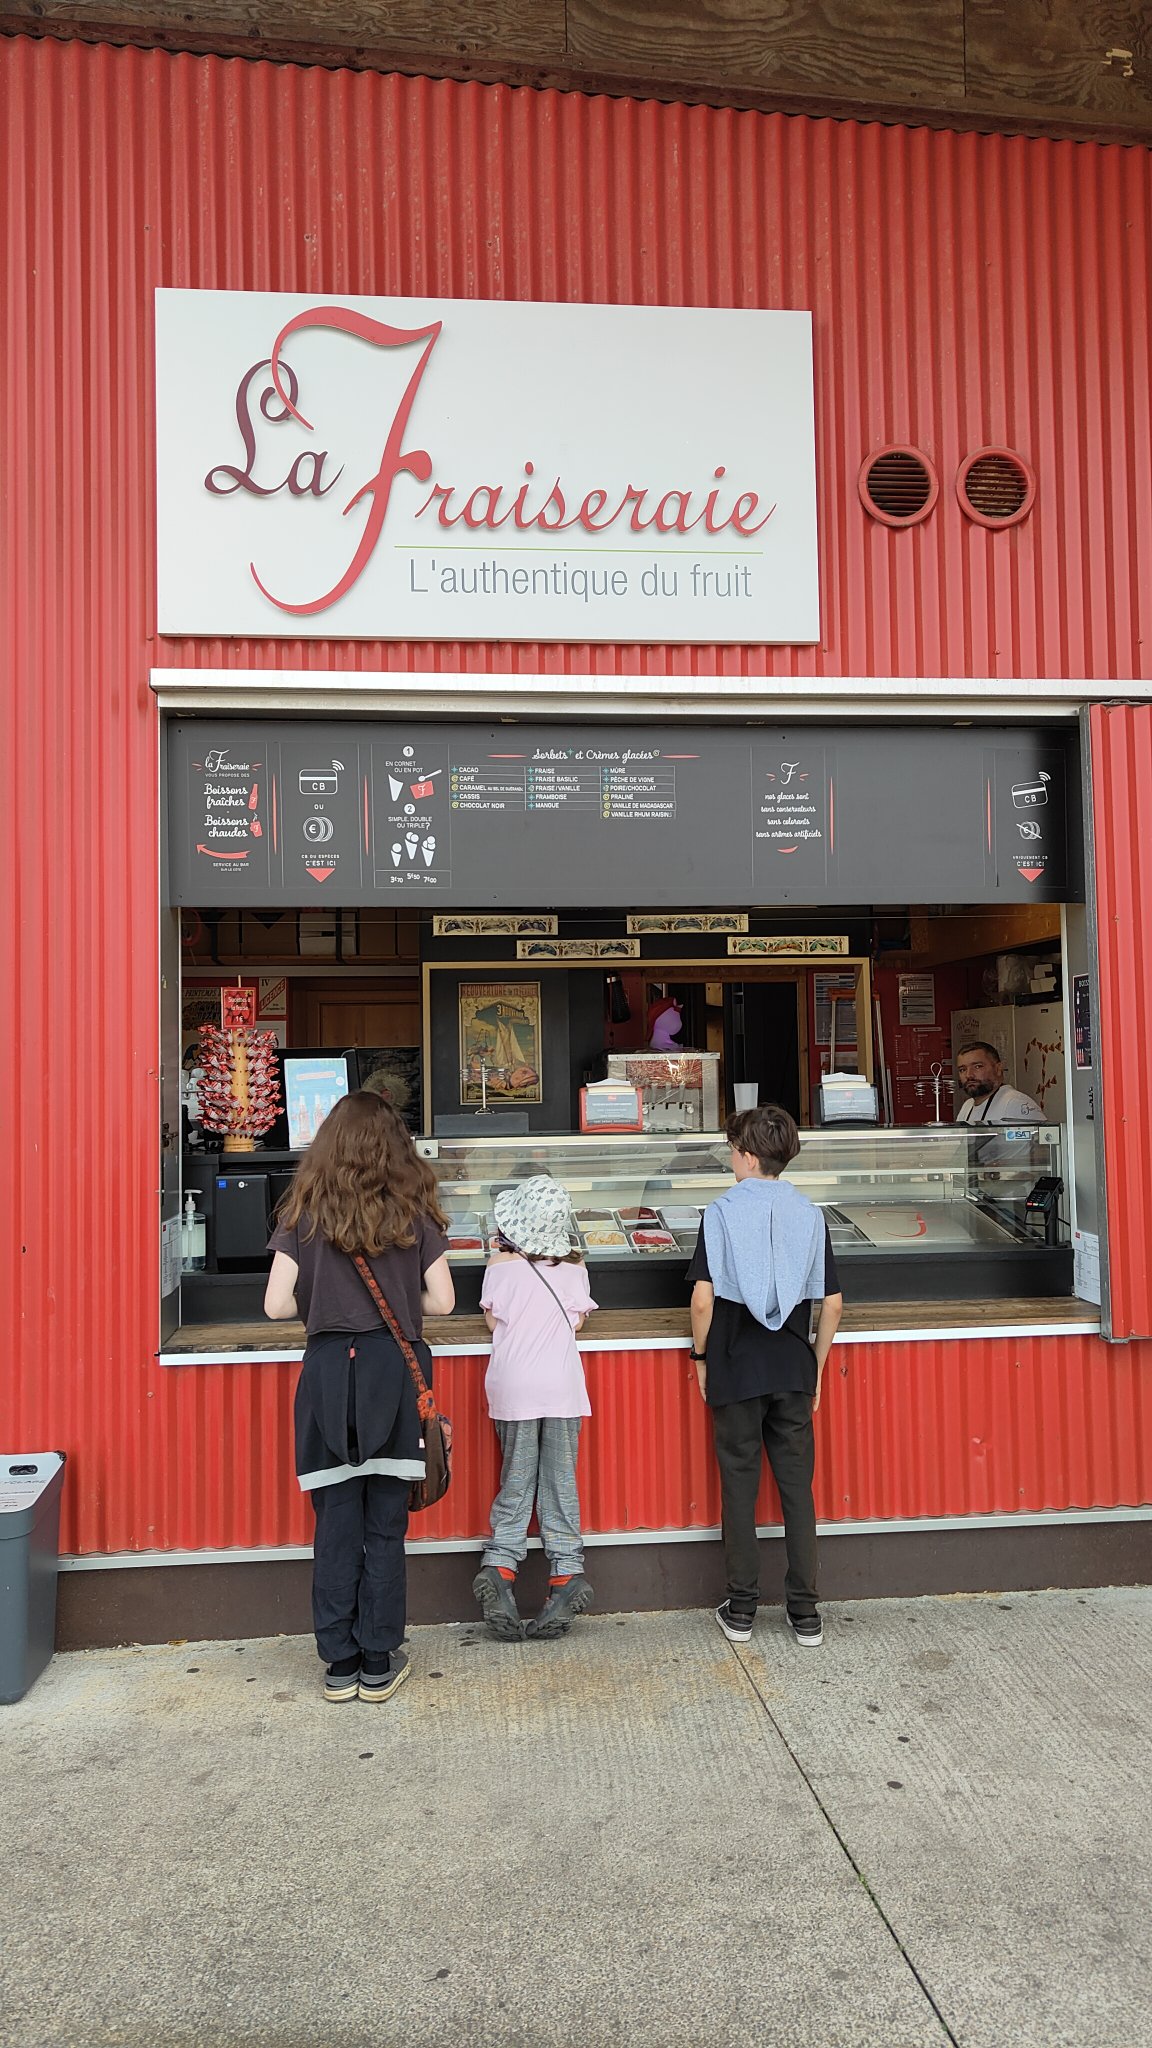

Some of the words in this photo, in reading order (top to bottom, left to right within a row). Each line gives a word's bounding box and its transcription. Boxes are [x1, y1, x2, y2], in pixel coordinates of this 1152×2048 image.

[204, 358, 345, 498] La
[250, 305, 777, 615] Fraiseraie
[409, 558, 628, 603] L'authentique
[640, 563, 679, 598] du
[689, 563, 753, 599] fruit
[531, 749, 568, 760] Sorbets
[575, 750, 583, 759] et
[586, 750, 620, 760] Crèmes
[621, 749, 654, 764] glacées
[204, 783, 248, 795] Boissons
[312, 782, 326, 790] CB
[206, 796, 246, 810] fraîches
[1024, 794, 1037, 803] CB
[204, 814, 249, 826] Boissons
[783, 816, 810, 825] colorants
[208, 826, 248, 838] chaudes
[794, 829, 822, 840] artificiels
